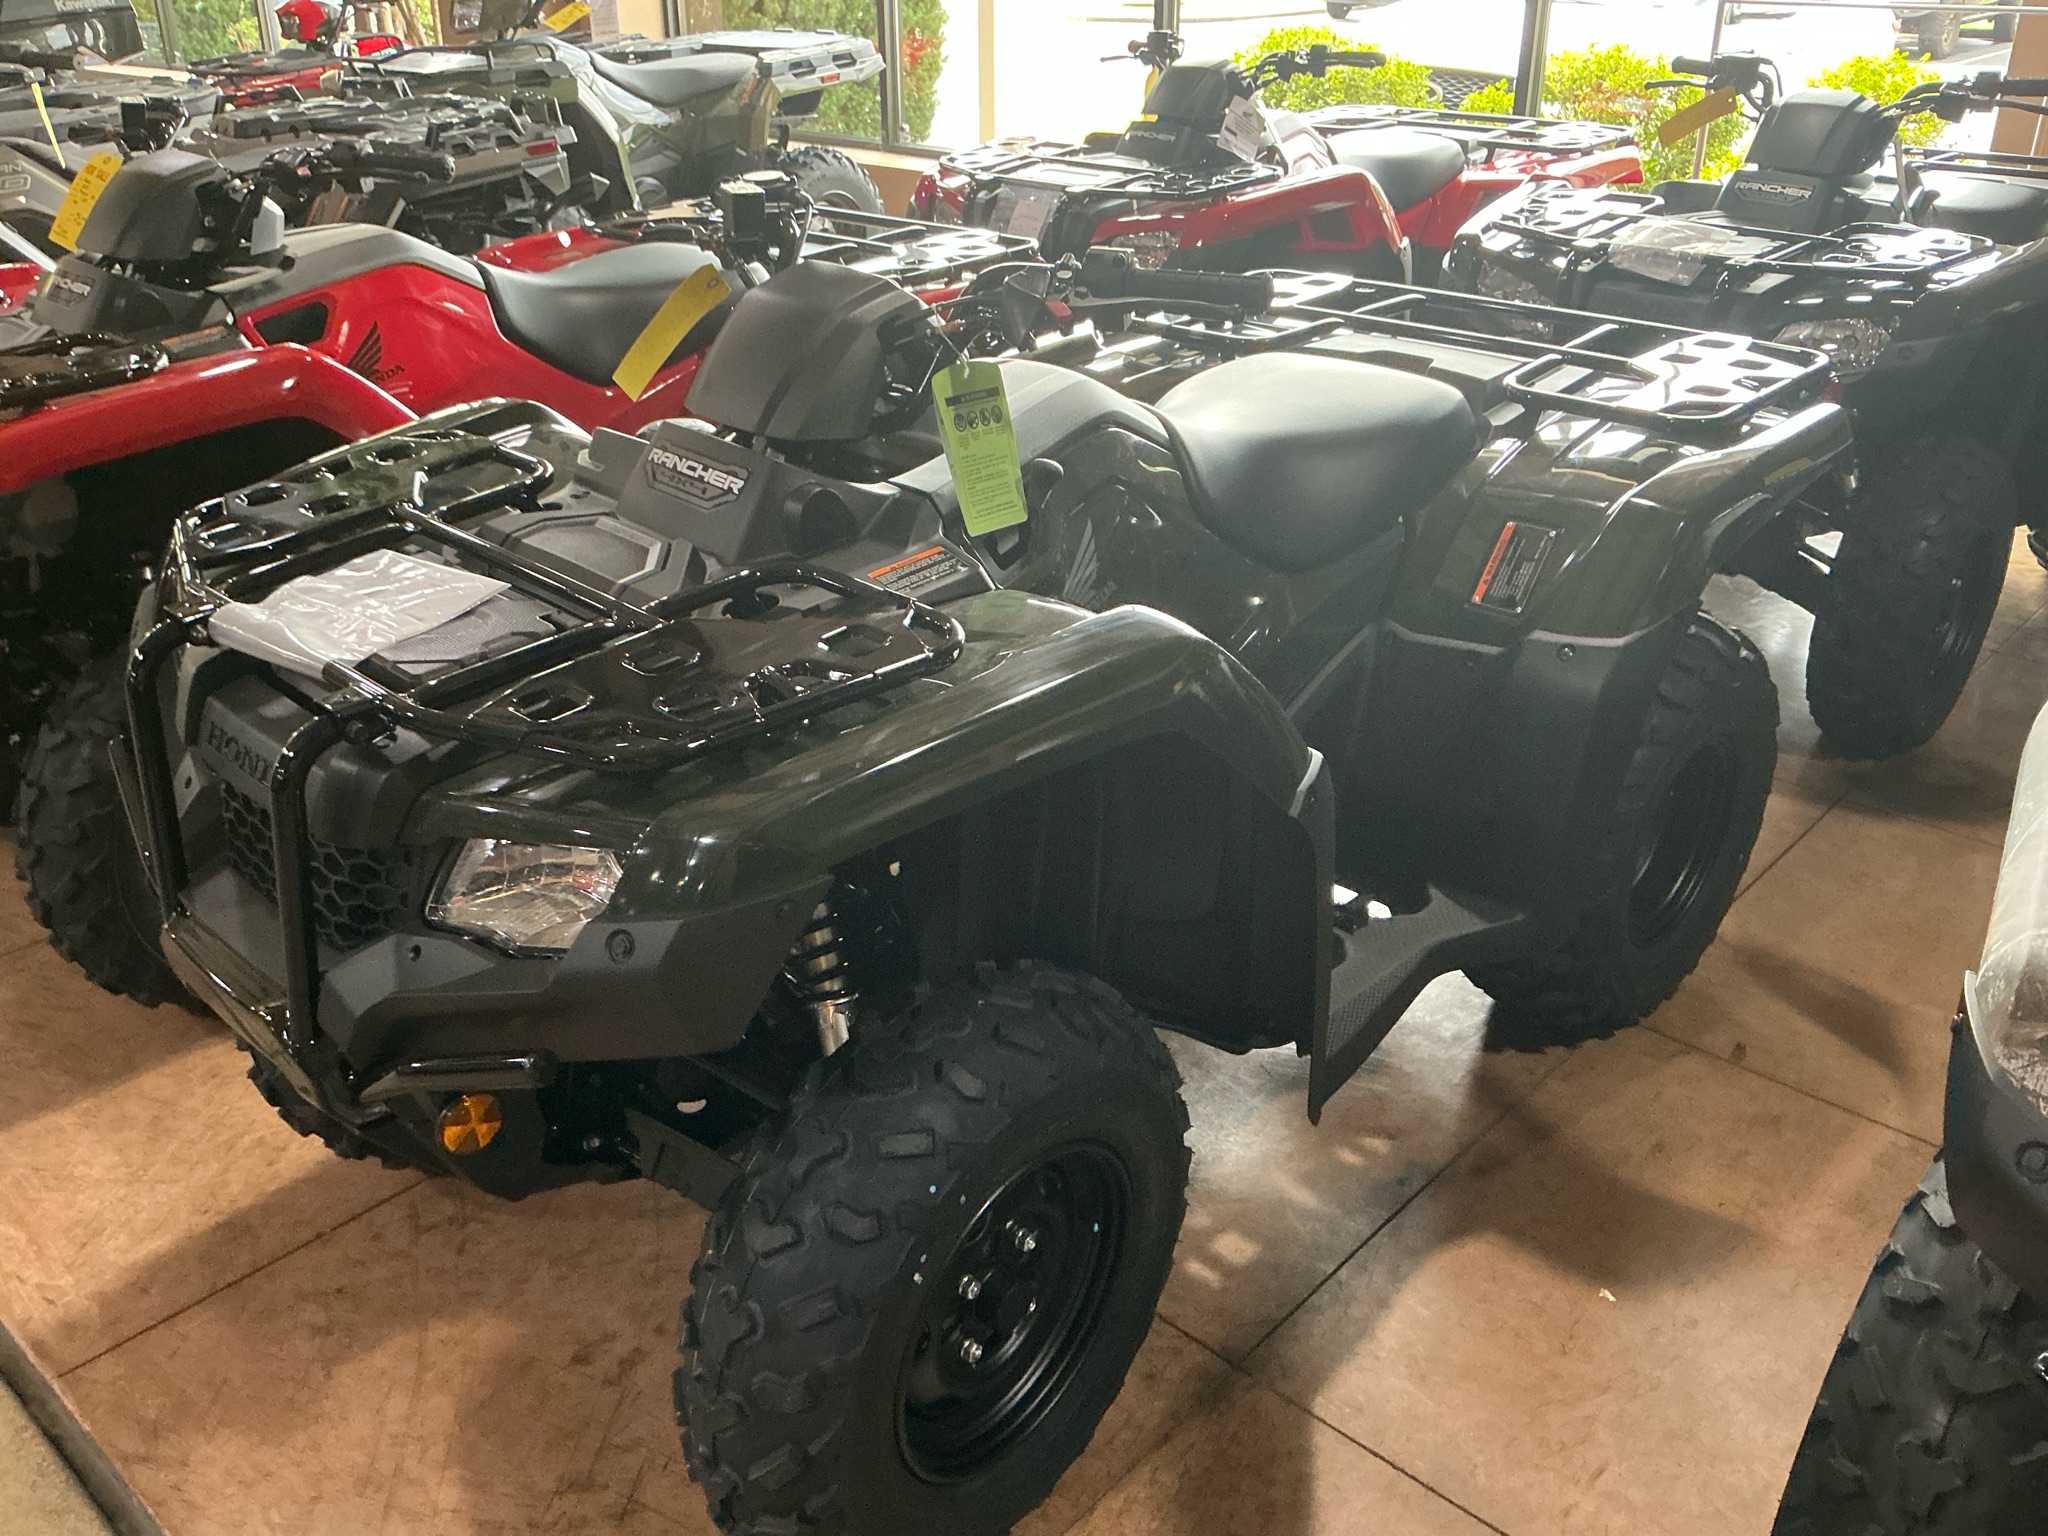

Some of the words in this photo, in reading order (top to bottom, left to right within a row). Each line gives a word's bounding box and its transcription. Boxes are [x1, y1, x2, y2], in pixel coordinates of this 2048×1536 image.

[1735, 181, 1812, 199] RANCHER
[648, 447, 745, 495] RANCHER
[207, 721, 268, 782] HON
